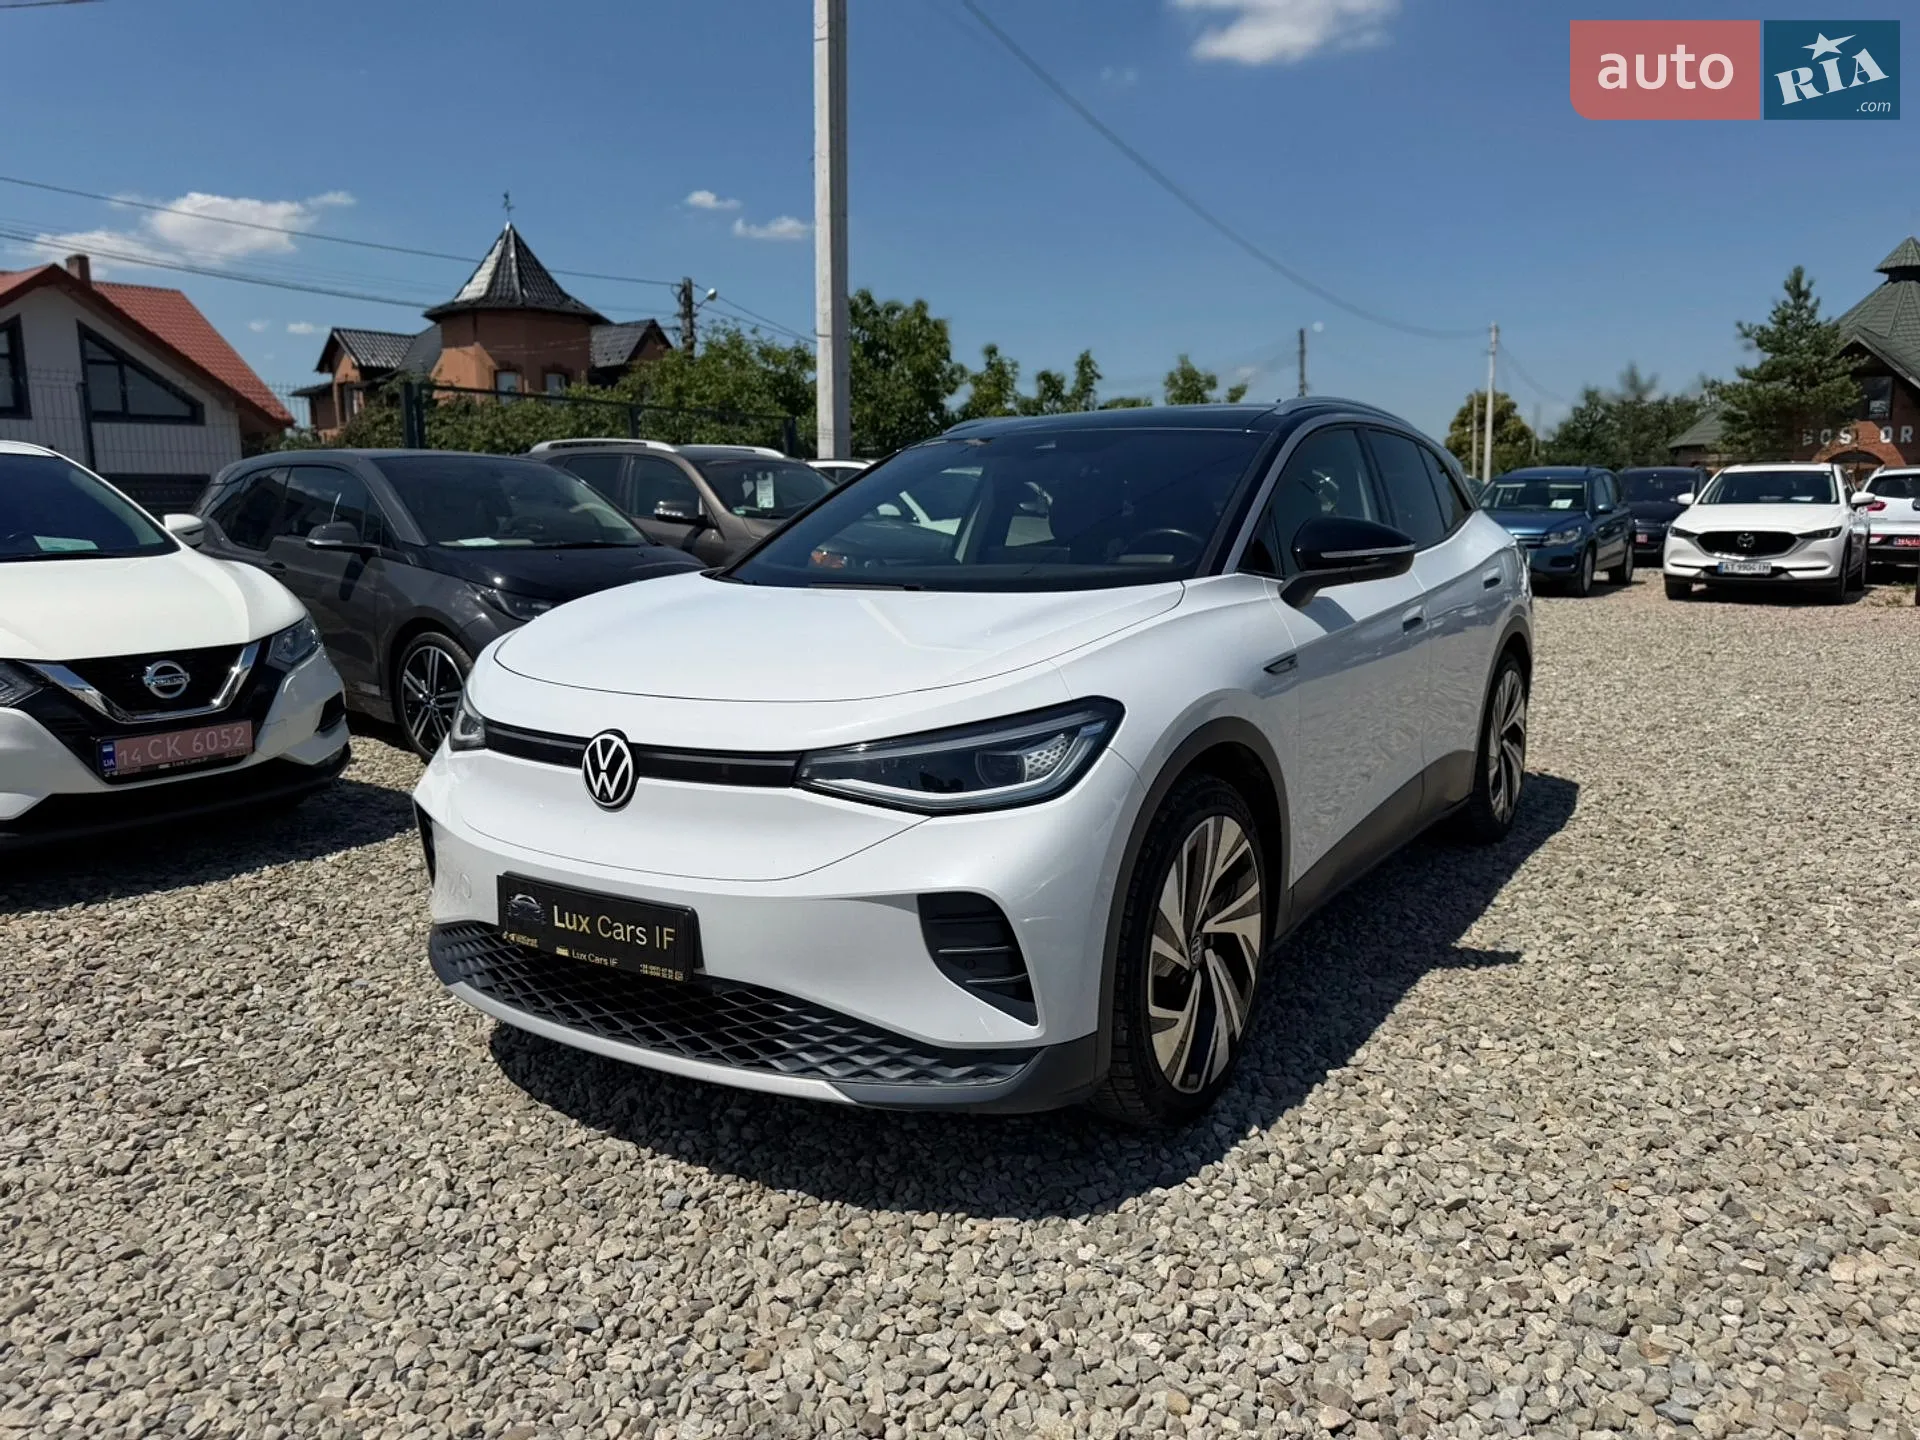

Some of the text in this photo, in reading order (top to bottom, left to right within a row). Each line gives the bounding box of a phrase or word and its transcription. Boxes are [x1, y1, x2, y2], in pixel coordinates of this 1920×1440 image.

[118, 726, 245, 766] 14 CK 6052
[553, 905, 676, 949] Lux Cars IF
[572, 949, 588, 961] Lux
[588, 953, 608, 966] Cars
